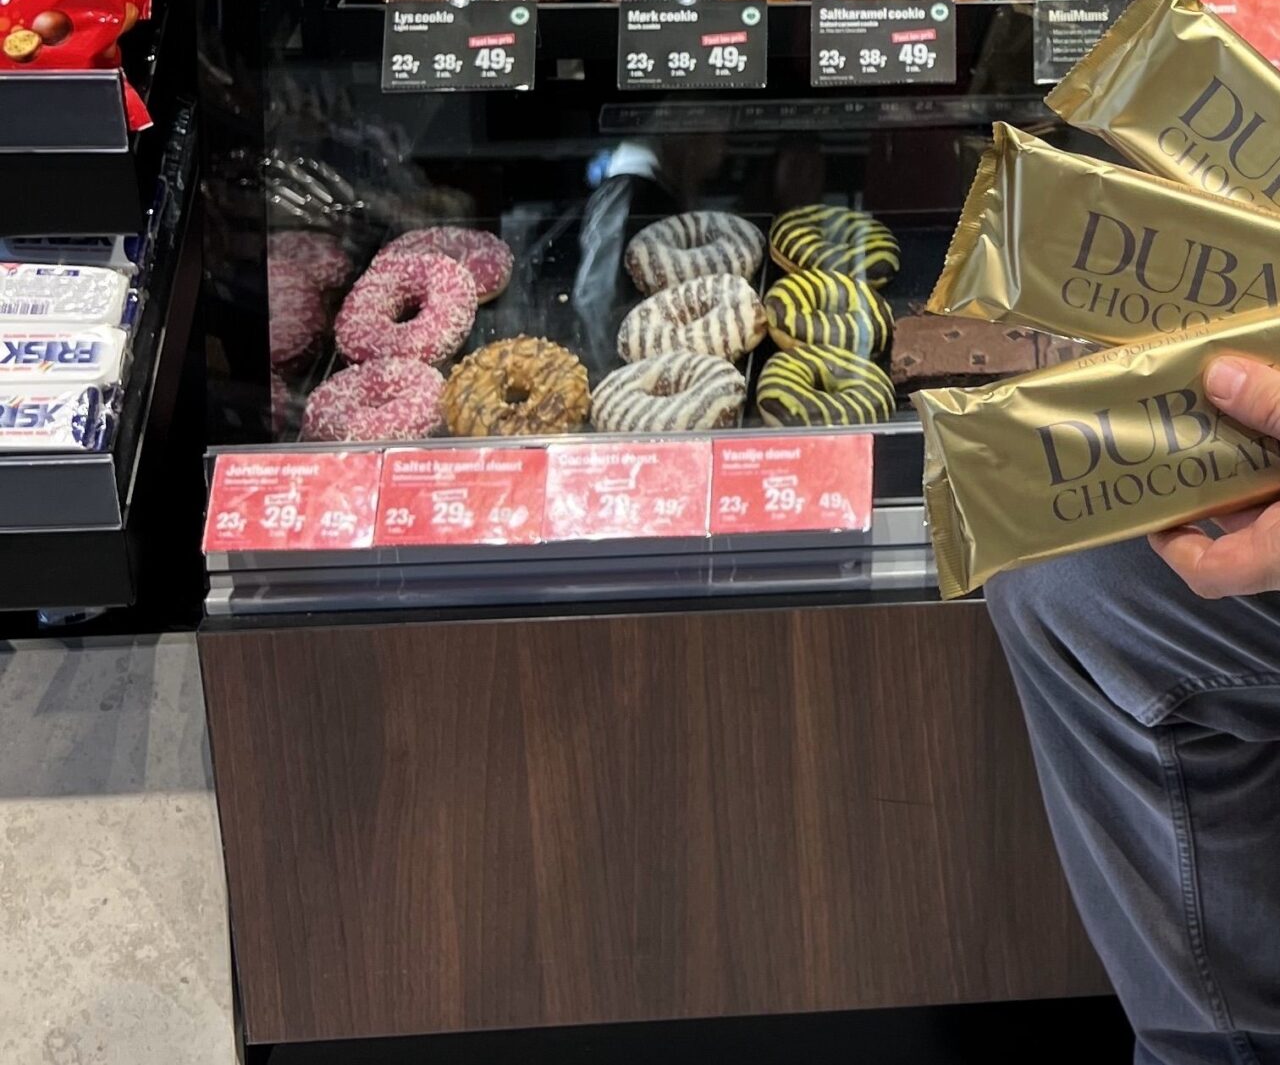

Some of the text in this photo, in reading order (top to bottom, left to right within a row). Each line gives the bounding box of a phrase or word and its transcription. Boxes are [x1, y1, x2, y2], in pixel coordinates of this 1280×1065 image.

[394, 11, 454, 24] Lys cookie
[628, 9, 698, 23] Mørk cookie
[820, 7, 926, 20] Saltkaramel cookie
[1048, 9, 1109, 22] MiniMums
[1, 341, 100, 364] FRISK
[0, 403, 65, 429] ISK
[765, 447, 801, 461] donut
